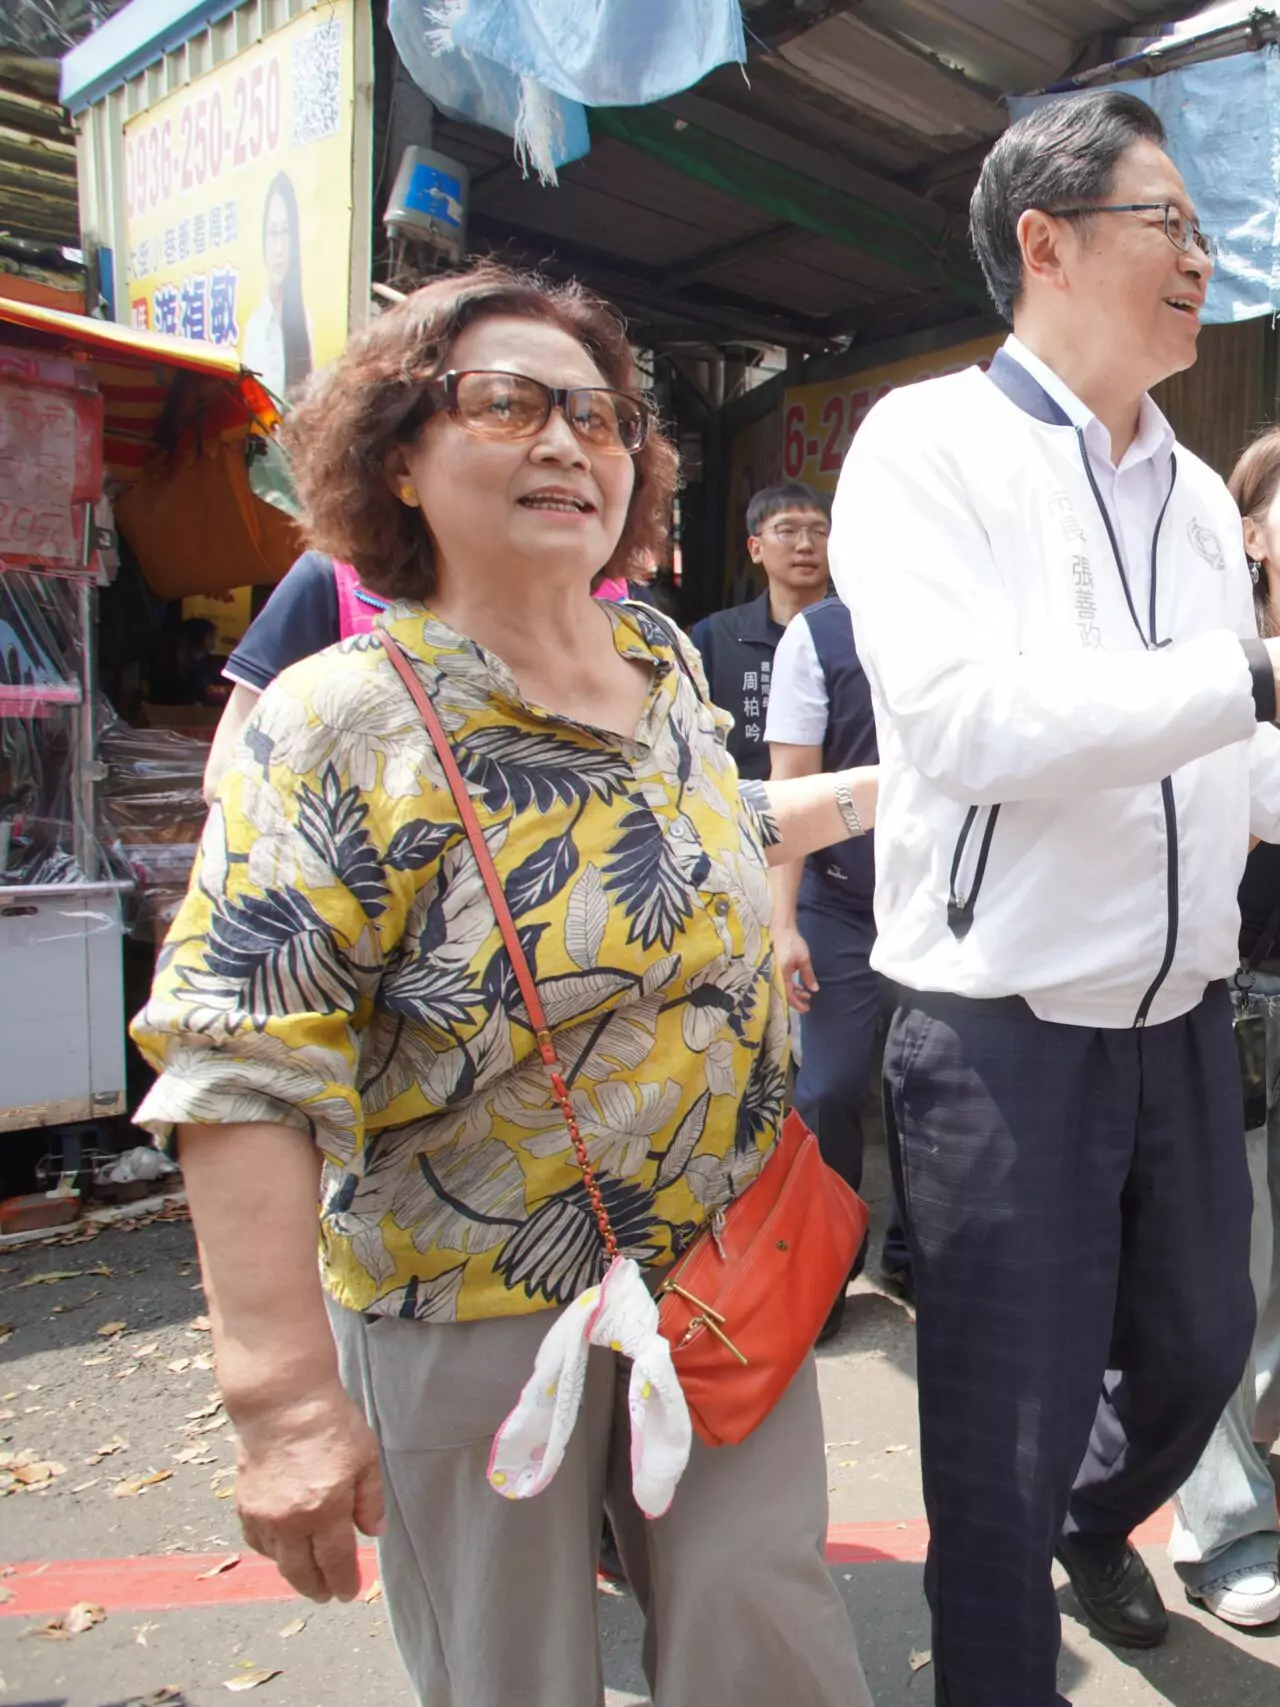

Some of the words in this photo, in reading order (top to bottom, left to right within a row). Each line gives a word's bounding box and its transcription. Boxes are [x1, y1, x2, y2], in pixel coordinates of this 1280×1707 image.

[126, 56, 282, 219] 0936-250-250
[742, 671, 761, 743] 周柏吟
